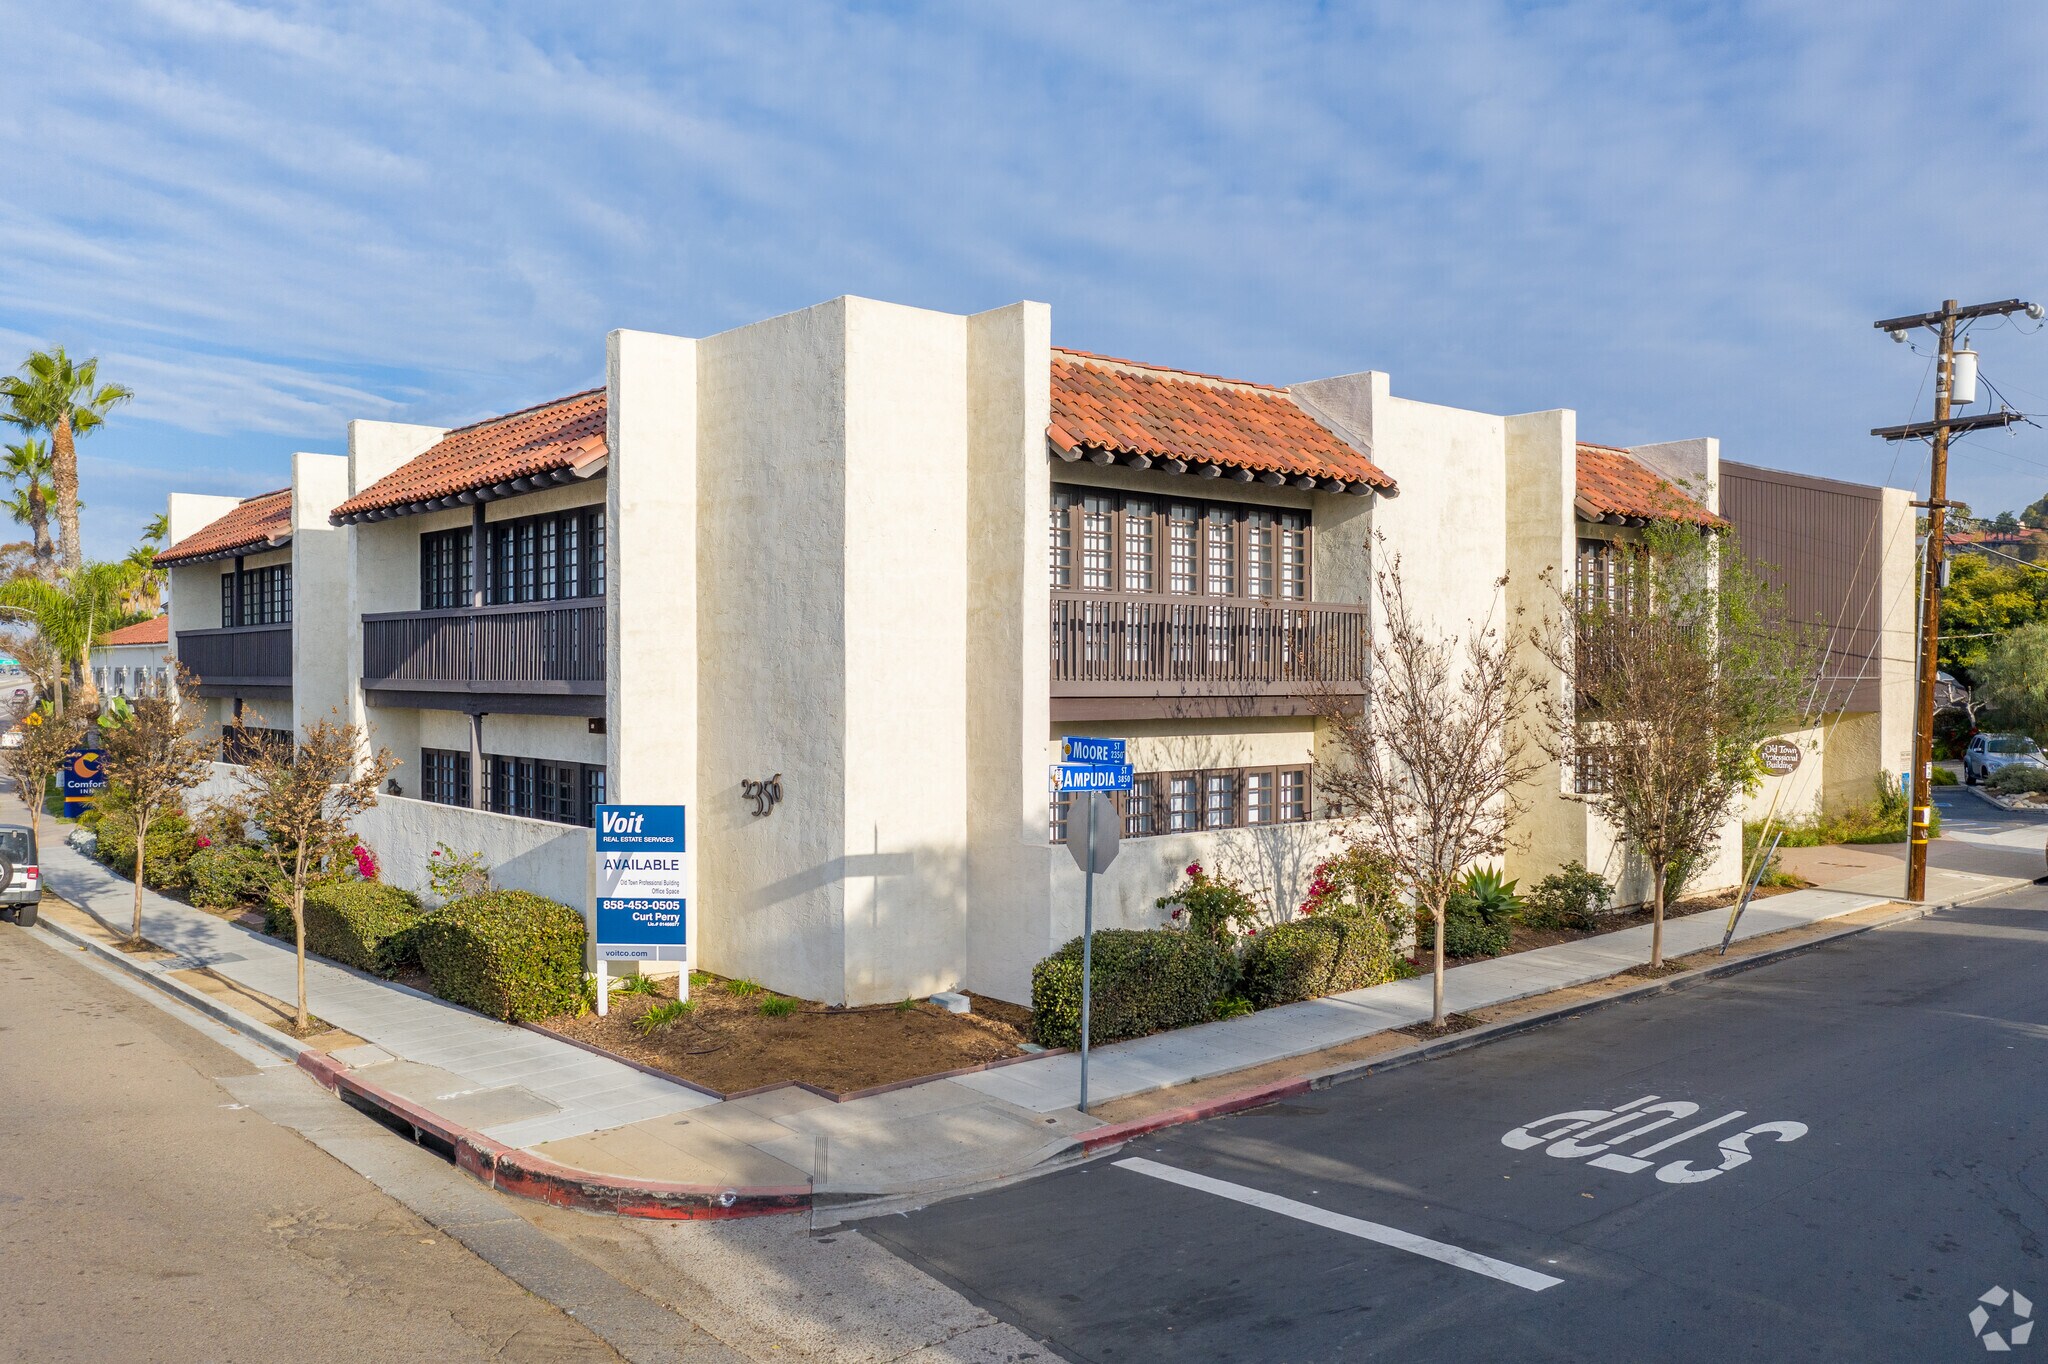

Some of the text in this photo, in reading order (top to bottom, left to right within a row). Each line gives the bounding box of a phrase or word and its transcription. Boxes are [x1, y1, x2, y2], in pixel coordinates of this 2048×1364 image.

[1073, 742, 1120, 761] MOORE ST
[1764, 745, 1797, 754] Old Town
[1761, 753, 1798, 761] Professional
[1766, 761, 1793, 772] Building
[1064, 769, 1115, 787] AMPUDIA
[1118, 775, 1131, 783] 3850
[602, 811, 644, 834] Voit
[604, 859, 679, 871] AVAILABLE
[603, 900, 680, 910] 858-453-0505
[632, 912, 680, 923] Curt Perry
[1501, 1095, 1809, 1184] STOP
